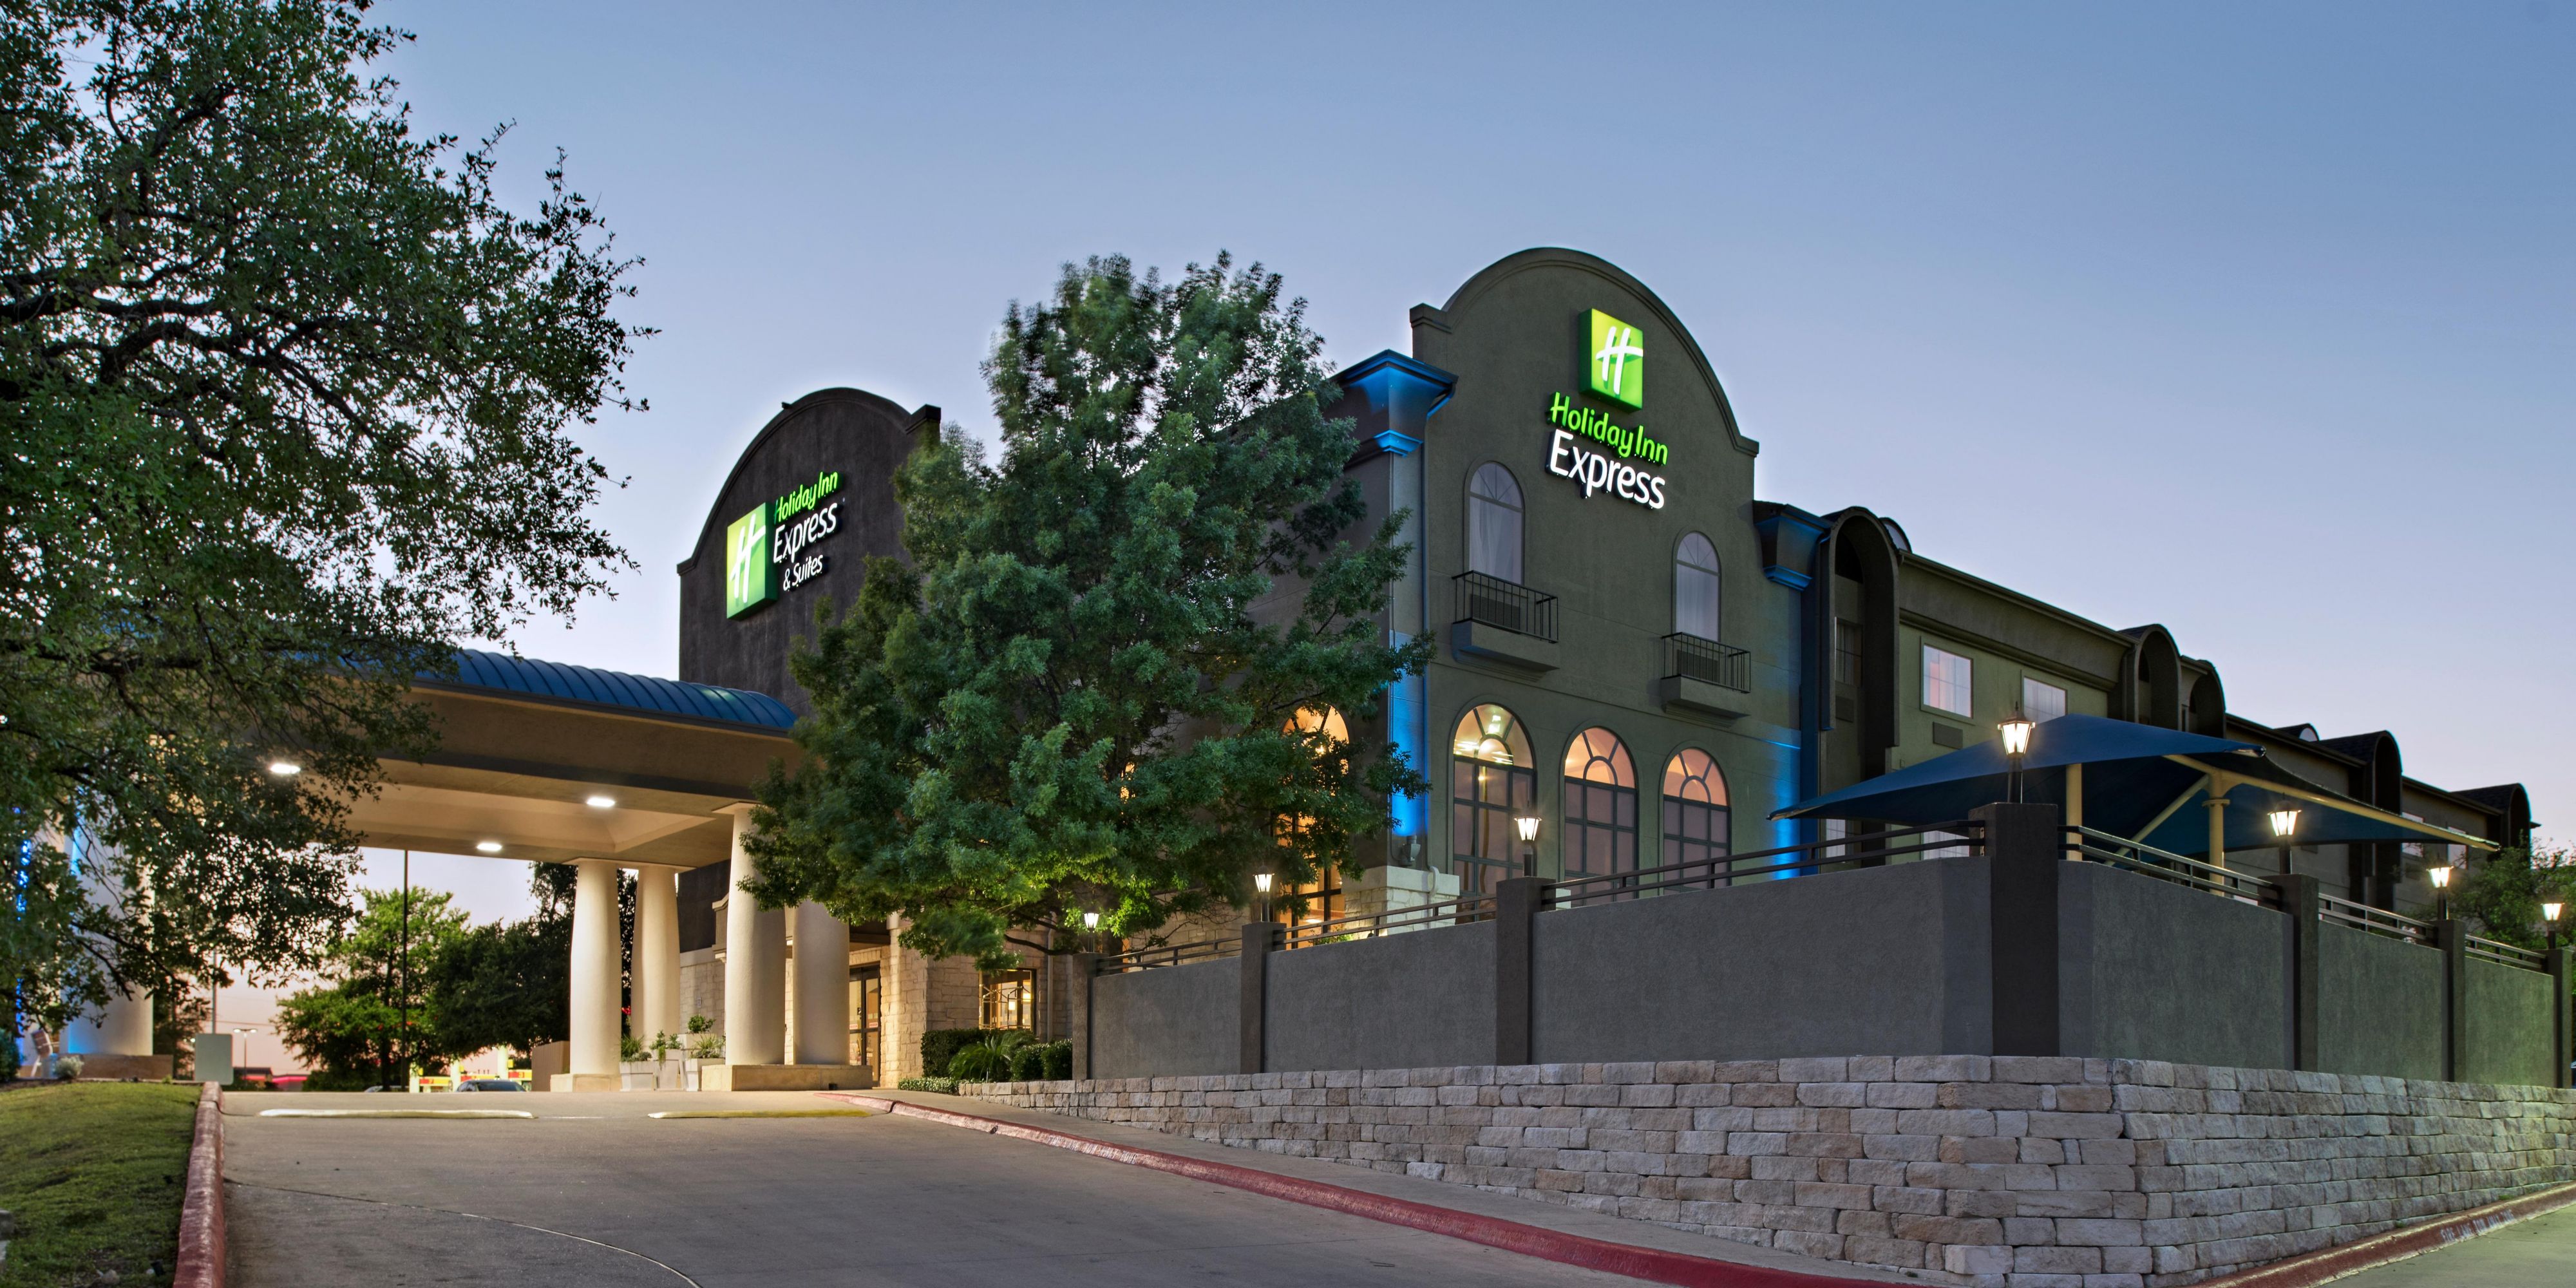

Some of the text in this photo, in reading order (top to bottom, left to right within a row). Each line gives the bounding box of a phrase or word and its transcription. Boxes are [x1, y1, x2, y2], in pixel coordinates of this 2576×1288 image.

[1549, 392, 1669, 466] Holiday Inn
[774, 471, 838, 525] Holiday Inn
[1549, 428, 1666, 509] Express
[773, 502, 838, 564] Express
[783, 554, 824, 591] & Suites
